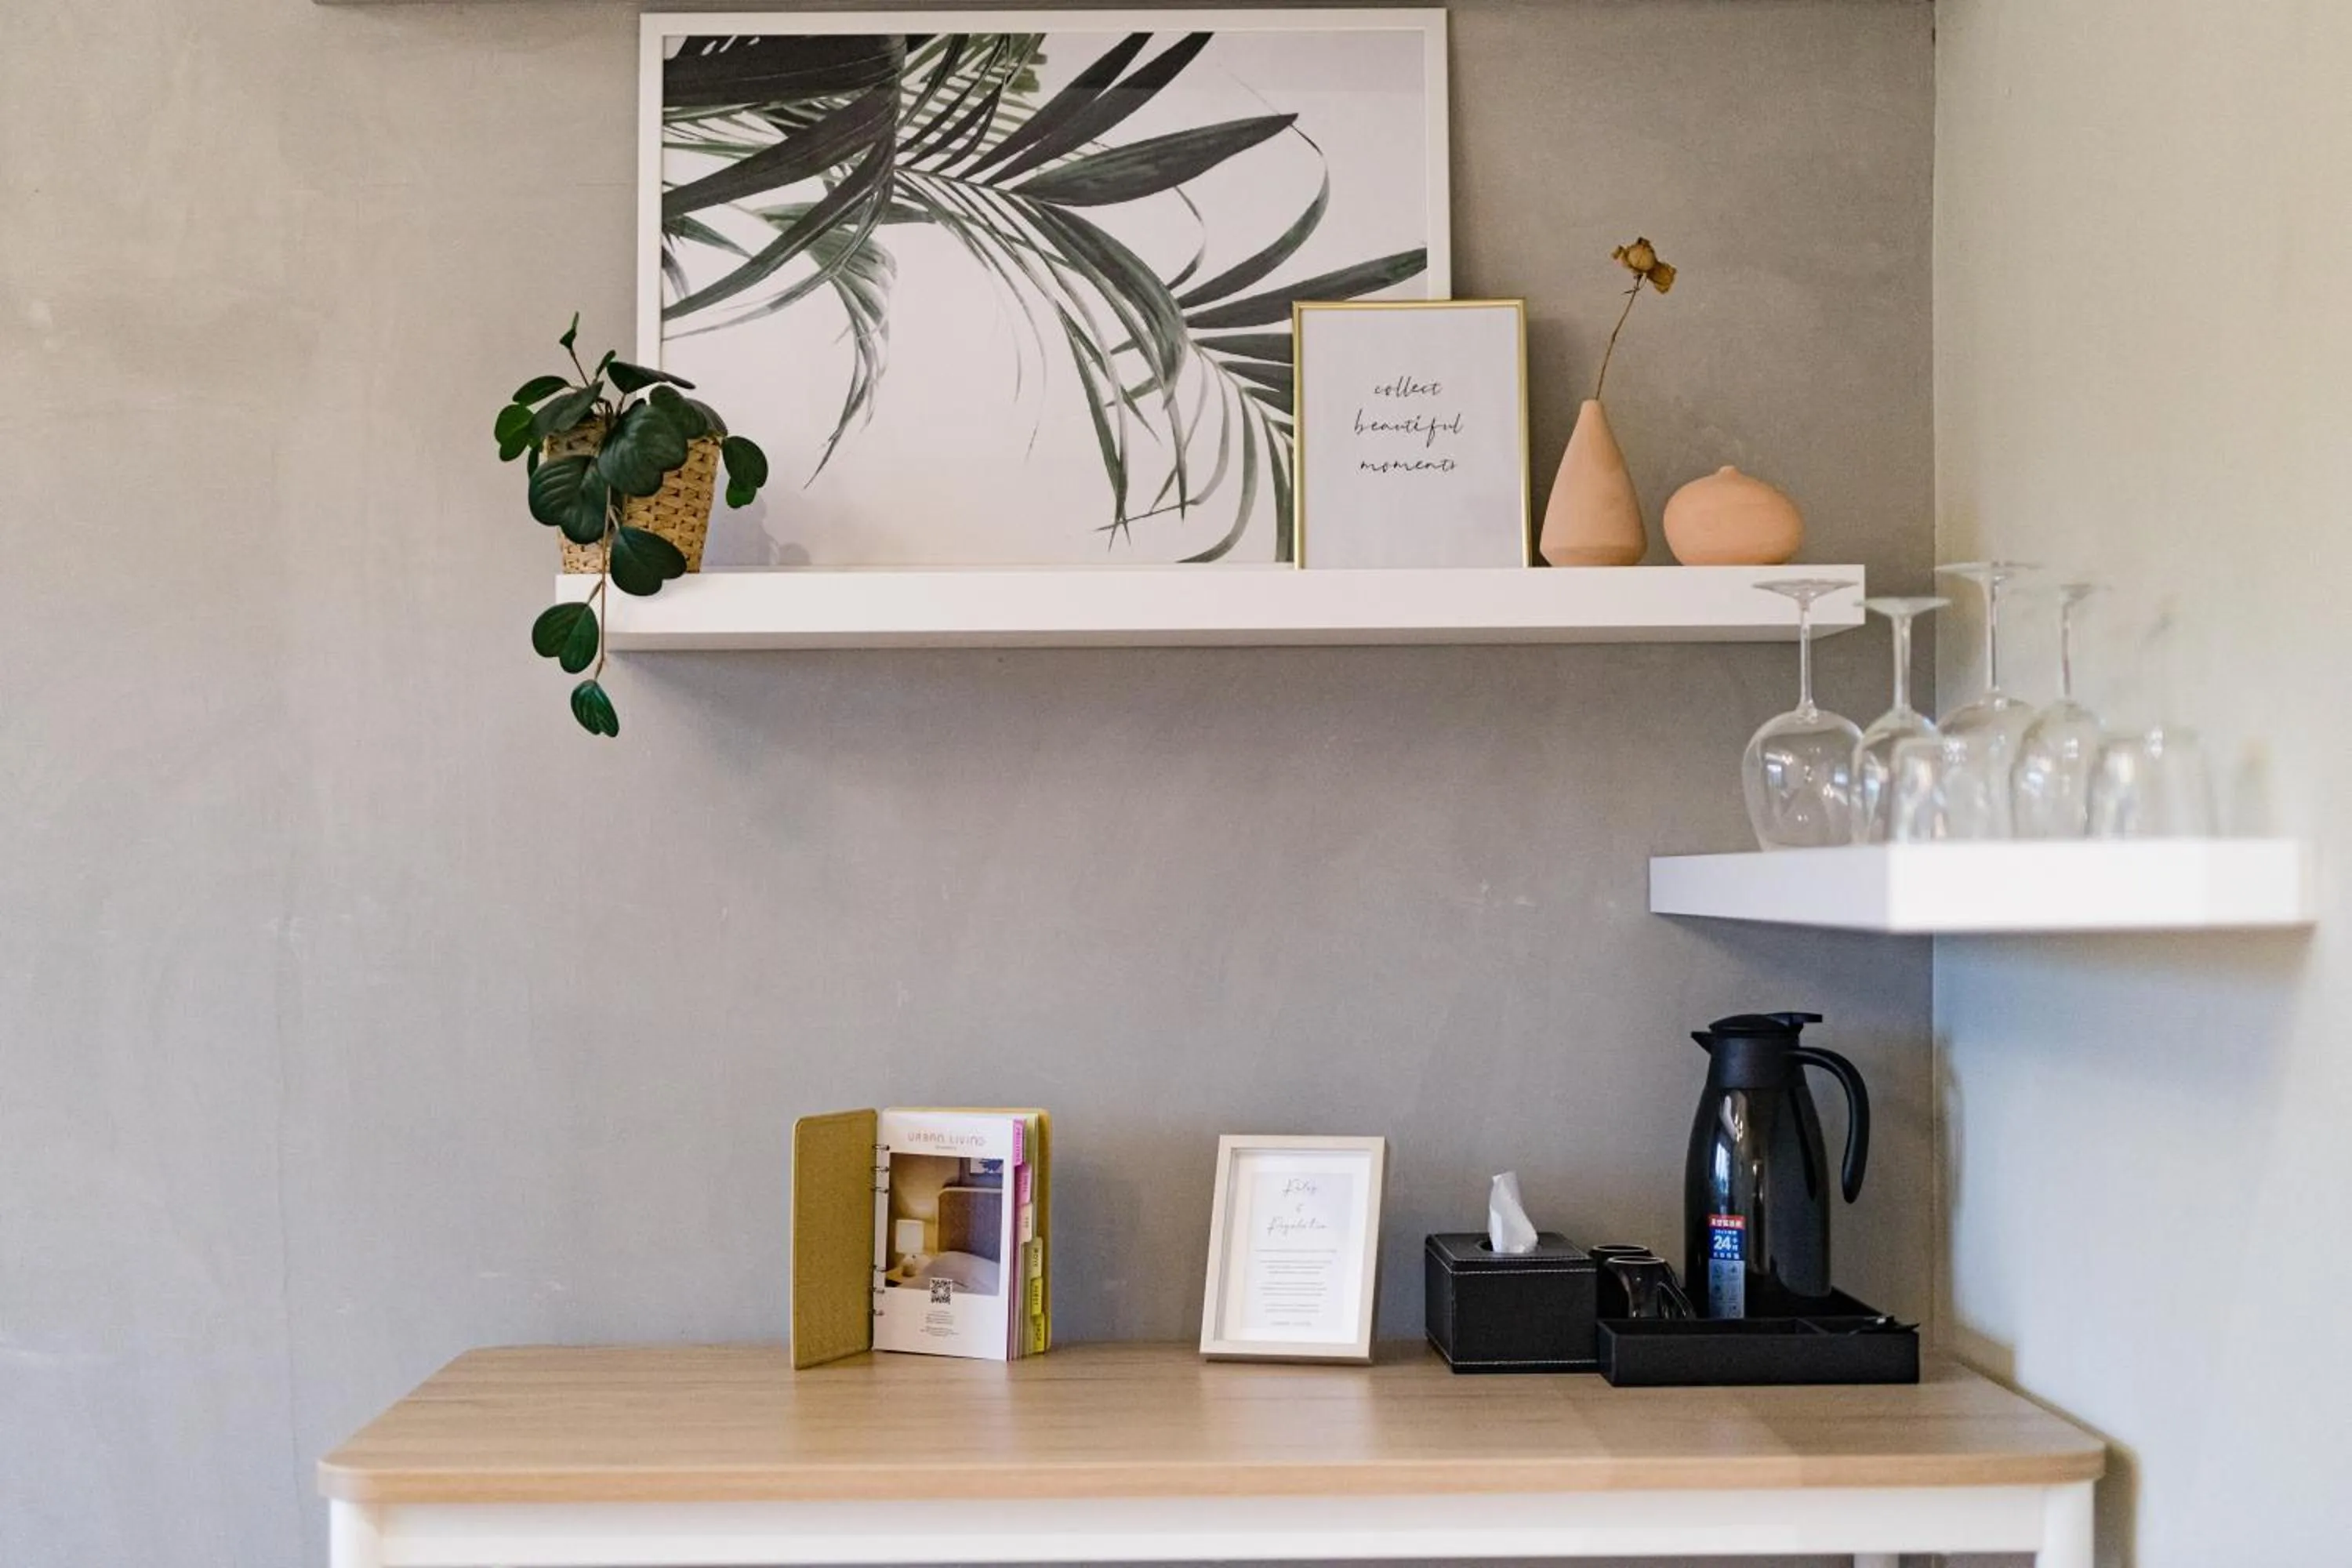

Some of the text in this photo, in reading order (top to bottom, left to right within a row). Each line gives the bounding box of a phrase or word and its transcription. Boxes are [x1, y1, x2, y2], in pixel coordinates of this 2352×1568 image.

[1374, 376, 1444, 397] collect
[1354, 408, 1464, 448] beautiful
[1359, 458, 1457, 474] moments
[1714, 1235, 1731, 1251] 24
